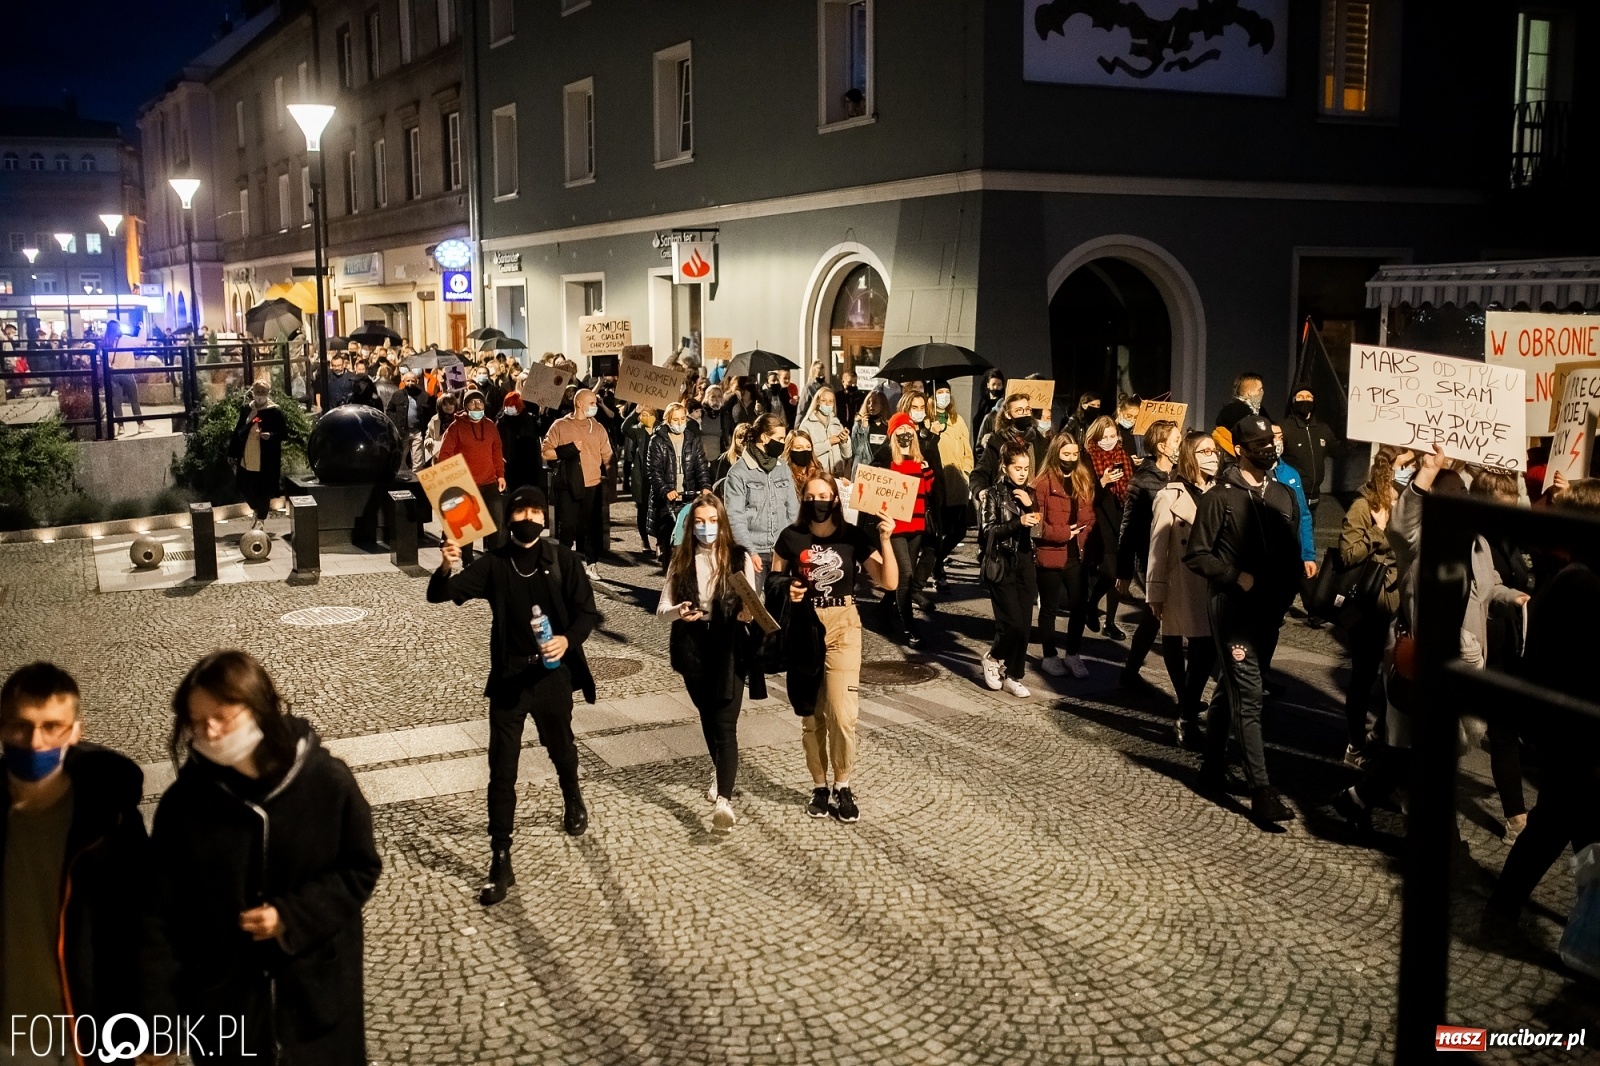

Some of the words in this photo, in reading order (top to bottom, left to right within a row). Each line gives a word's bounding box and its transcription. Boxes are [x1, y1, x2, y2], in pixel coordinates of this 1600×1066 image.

[585, 320, 630, 333] ZAJMIJCIE
[1490, 330, 1507, 356] W
[1518, 326, 1599, 357] OBRONIE
[1360, 350, 1419, 374] MARS
[1433, 360, 1456, 377] OD
[626, 365, 640, 378] NO
[643, 369, 678, 387] WOMEN
[629, 381, 644, 393] NO
[645, 383, 669, 399] KRAJ
[1350, 386, 1361, 402] A
[1367, 387, 1399, 405] PIS
[1415, 393, 1443, 408] OD
[1391, 376, 1420, 390] TO
[1435, 381, 1493, 405] SRAM
[1367, 404, 1416, 422] JEST
[1425, 410, 1443, 426] W
[1447, 414, 1511, 443] DUPĘ
[1400, 421, 1489, 456] JEBANY
[1482, 453, 1519, 469] ELO
[857, 469, 893, 485] PROTEST
[875, 486, 906, 500] KOBIET
